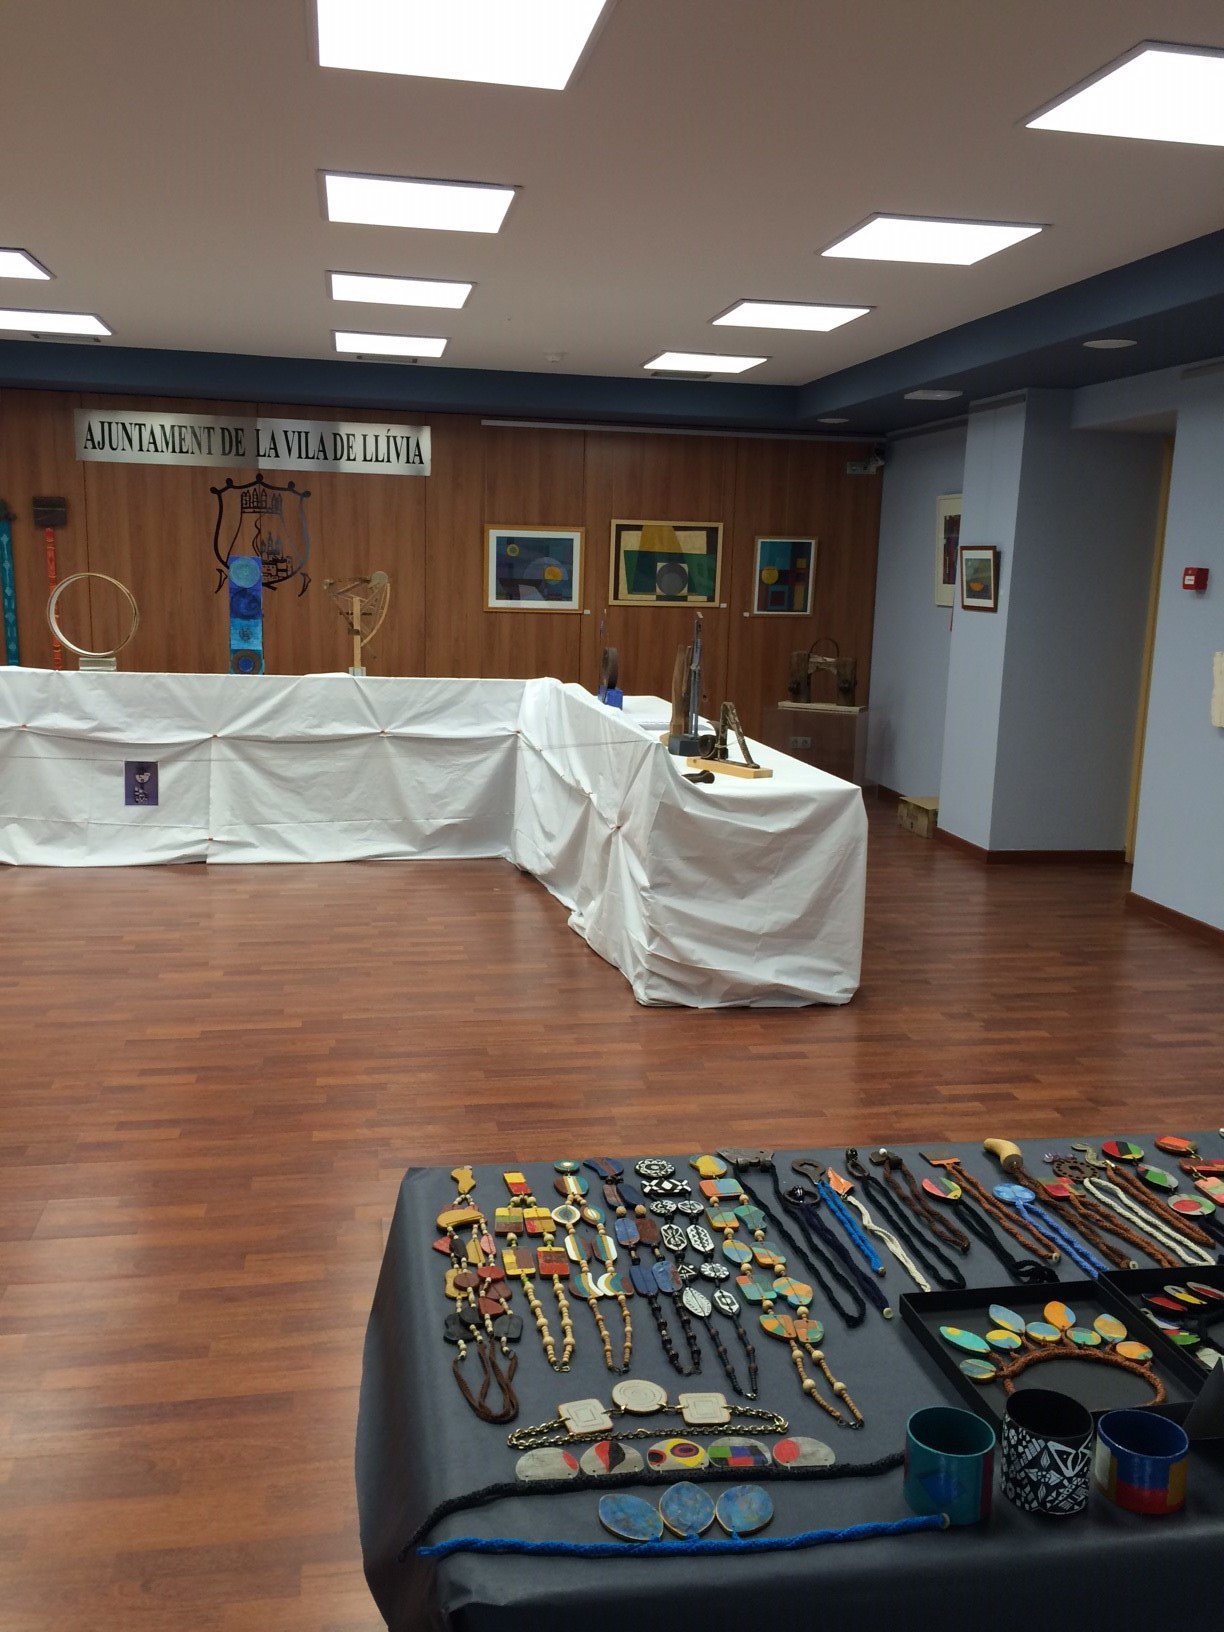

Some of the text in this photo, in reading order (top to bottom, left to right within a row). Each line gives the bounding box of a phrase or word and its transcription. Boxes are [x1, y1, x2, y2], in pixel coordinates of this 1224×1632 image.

[83, 420, 425, 465] AJUNTAMENT DE LA VILA DE LLÍVIA
